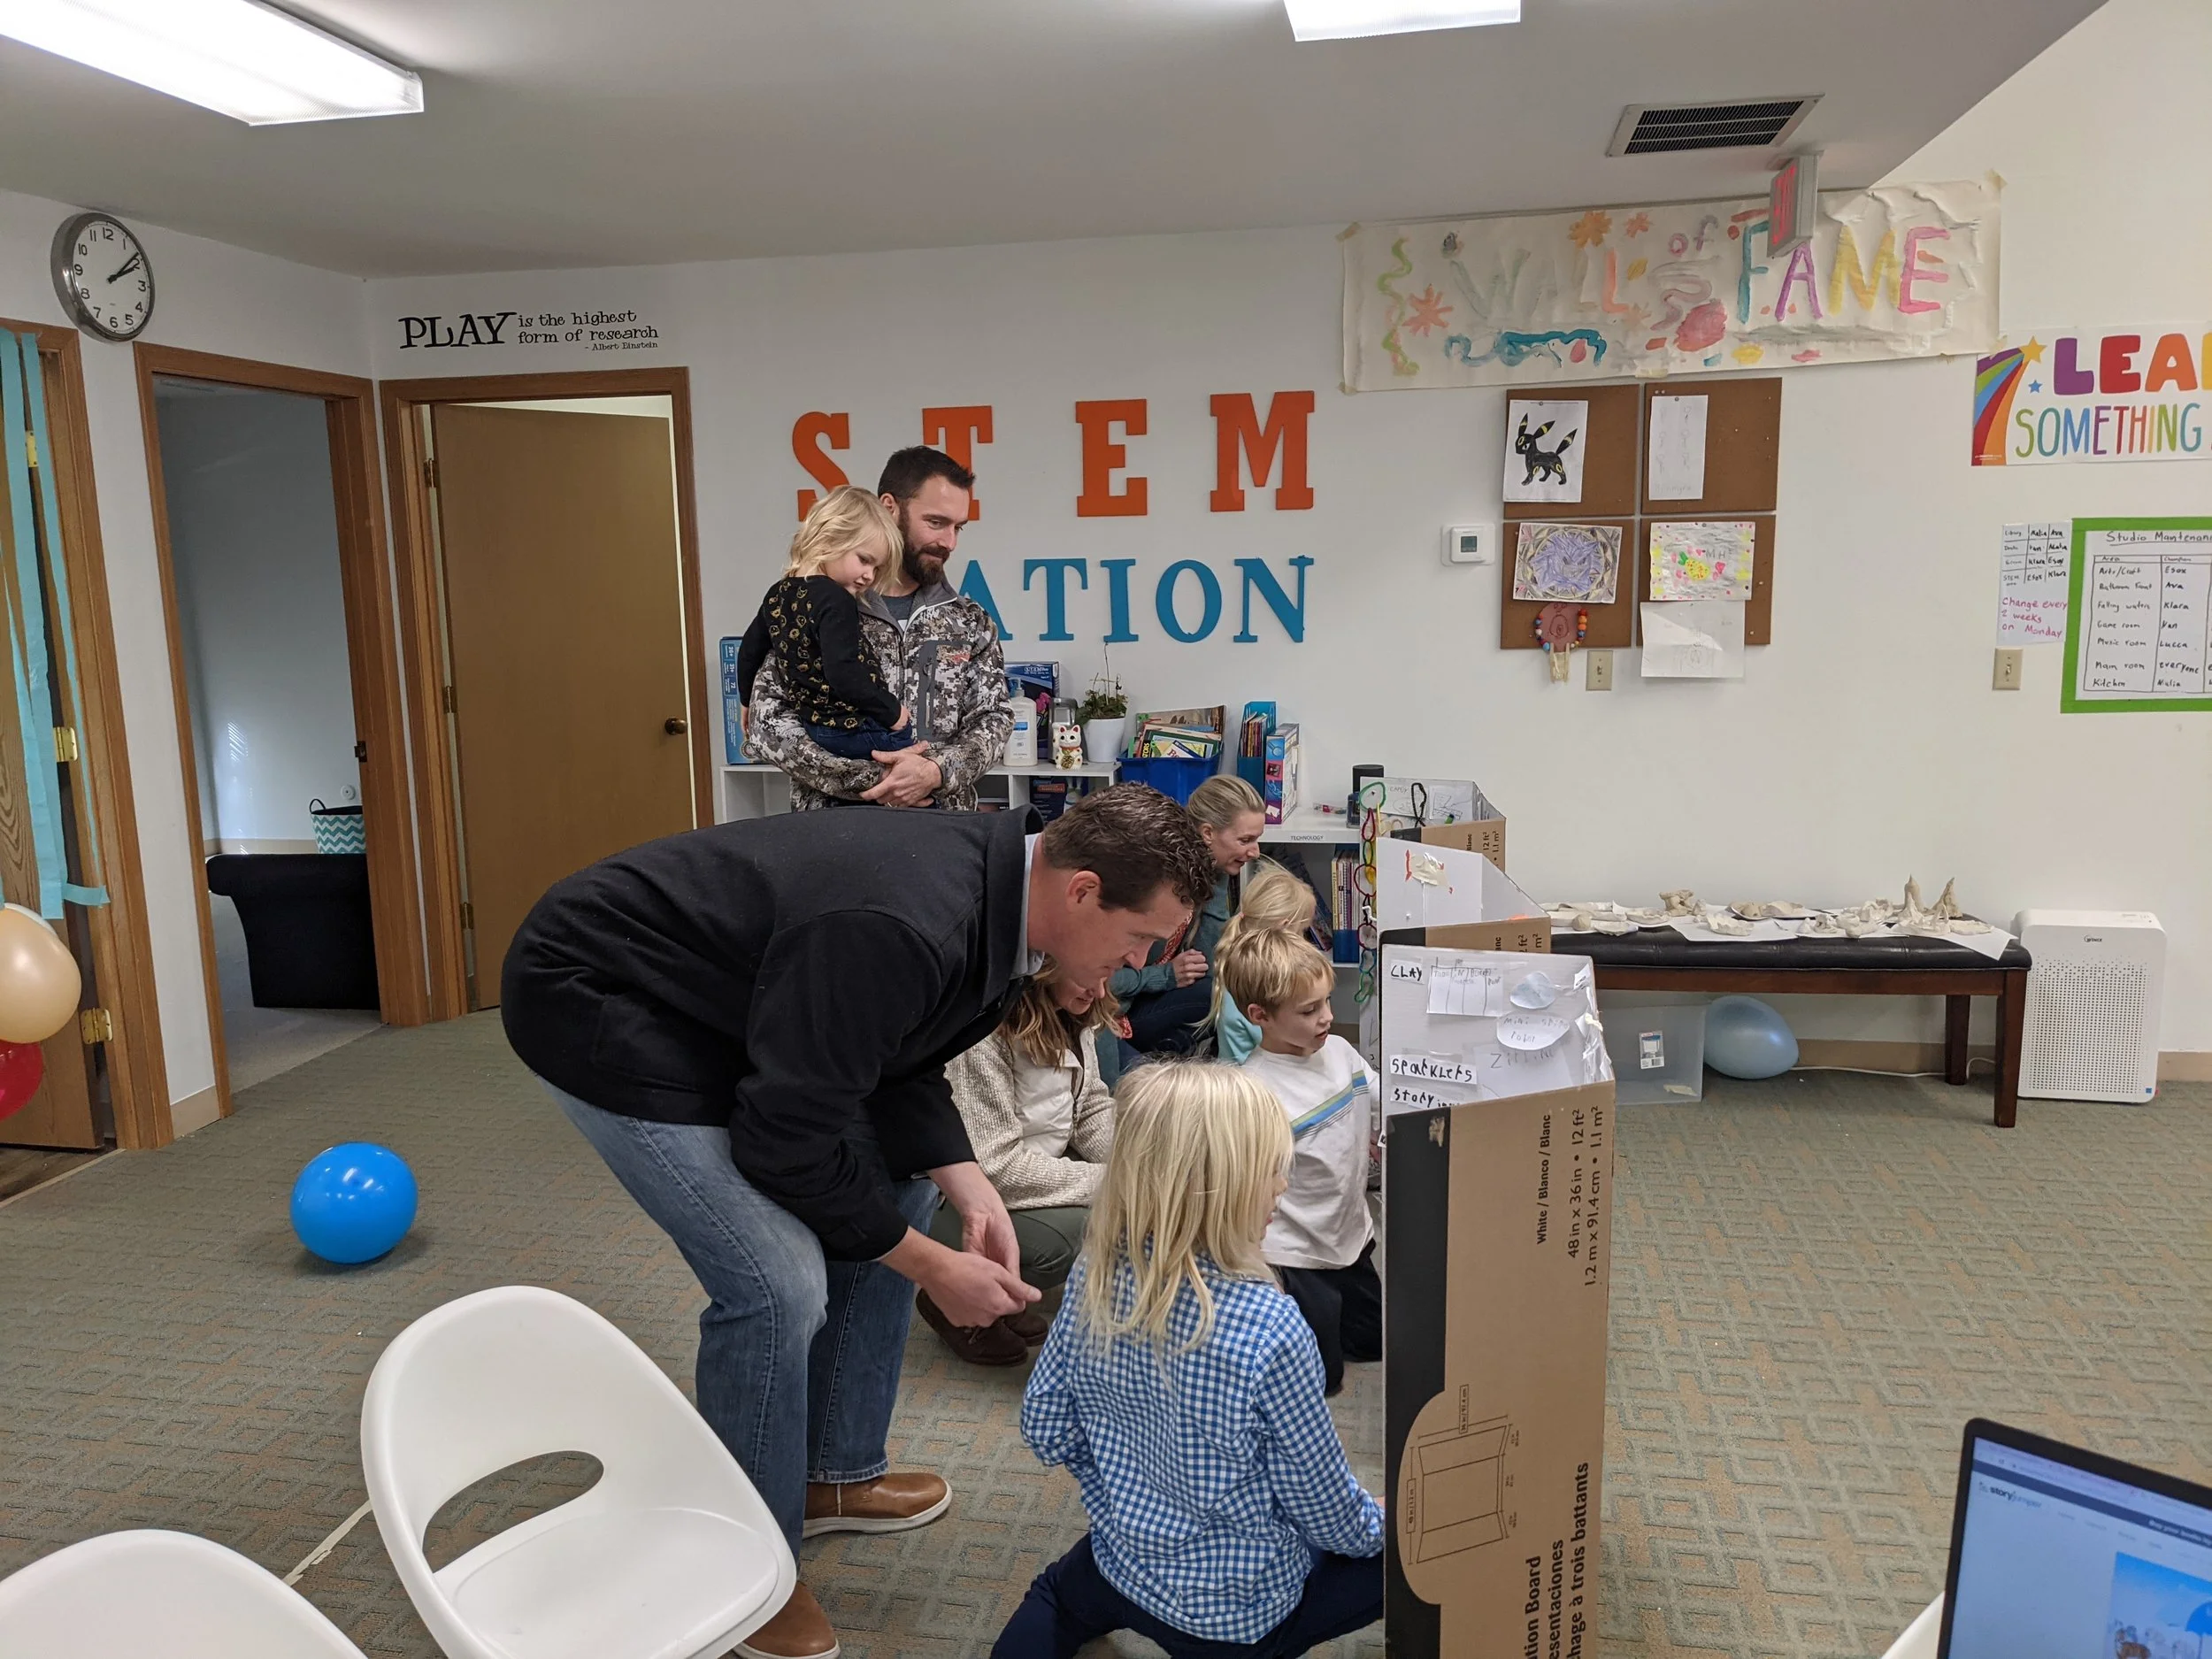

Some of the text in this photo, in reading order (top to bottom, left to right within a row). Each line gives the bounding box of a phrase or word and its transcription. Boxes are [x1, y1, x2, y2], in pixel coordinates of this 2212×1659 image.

[89, 229, 96, 242] 11
[102, 227, 114, 241] 12
[78, 243, 88, 256] 10
[74, 264, 83, 276] 9
[1669, 215, 1719, 253] of
[1736, 221, 1952, 327] FAME
[138, 280, 146, 292] 3
[81, 288, 90, 300] 8
[93, 306, 101, 319] 7
[134, 302, 143, 312] 4
[109, 317, 118, 328] 6
[125, 314, 134, 326] 5
[398, 310, 636, 349] PLAY is the highest
[518, 326, 658, 344] form of research
[622, 342, 658, 350] Einstein
[2054, 332, 2212, 396] LEA
[2015, 403, 2201, 458] SOMETHING
[2107, 531, 2147, 541] Studio
[959, 557, 1315, 643] ATION
[2002, 597, 2067, 611] Change every
[2098, 601, 2119, 612] Falling
[2001, 609, 2041, 623] 2 weeks
[2024, 625, 2062, 637] Monday
[2098, 637, 2119, 646] Music
[2159, 662, 2199, 673] everyone
[2093, 679, 2125, 687] Kitchen
[1390, 964, 1423, 982] CLAY
[1540, 1114, 1551, 1148] Blanc
[1572, 1128, 1584, 1145] 12
[1590, 1129, 1601, 1148] 1.1
[1538, 1158, 1549, 1200] Blanco
[1571, 1168, 1582, 1183] in
[1592, 1170, 1600, 1194] cm
[1570, 1185, 1582, 1204] 36
[1587, 1198, 1599, 1227] 91.4
[1537, 1210, 1547, 1245] White
[1568, 1240, 1579, 1258] 48
[1589, 1246, 1597, 1261] m
[1585, 1265, 1596, 1286] 1.2
[1571, 1462, 1589, 1544] battants
[1571, 1546, 1586, 1589] trois
[1525, 1555, 1541, 1614] Board
[1548, 1540, 1563, 1659] esentaciones
[1570, 1594, 1583, 1608] à
